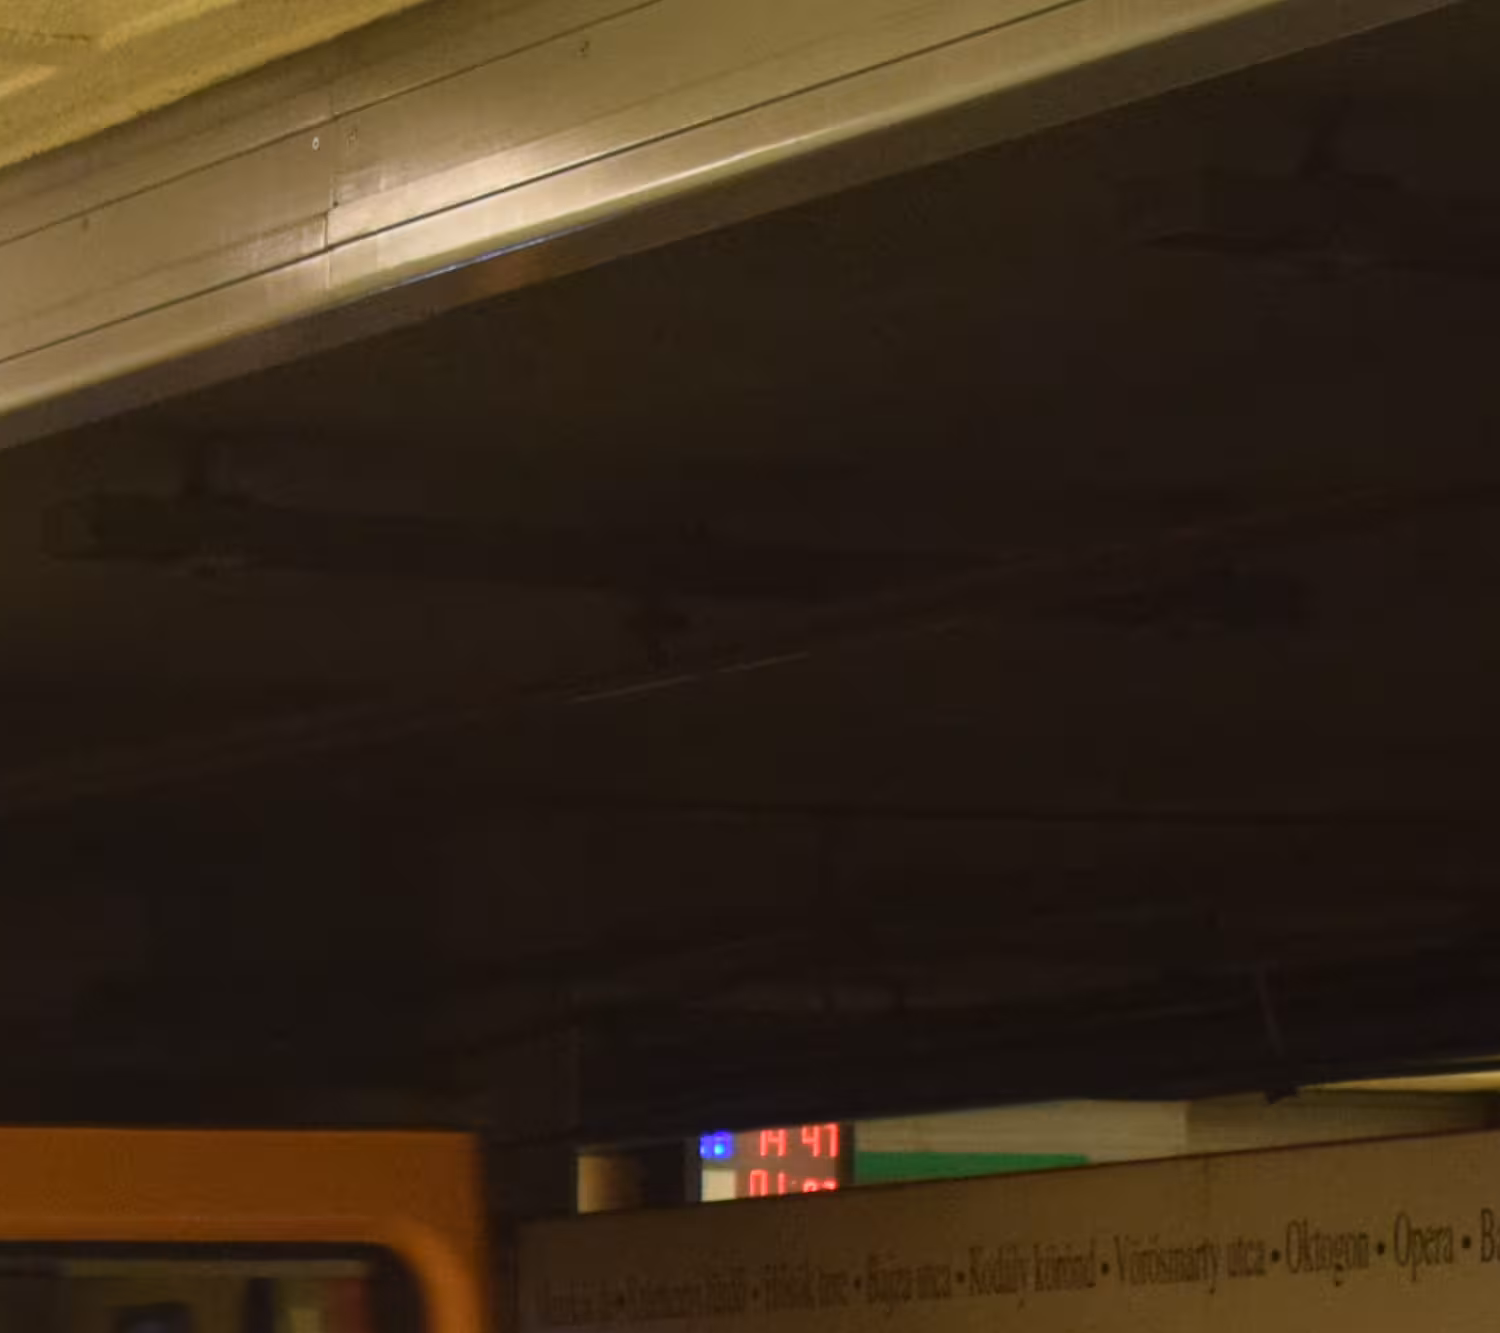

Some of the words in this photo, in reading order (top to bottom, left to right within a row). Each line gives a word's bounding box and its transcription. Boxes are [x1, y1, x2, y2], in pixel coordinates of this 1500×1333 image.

[1113, 1233, 1217, 1295] Vörösmarty
[1286, 1218, 1370, 1288] Oktogon
[1394, 1210, 1455, 1283] Opera
